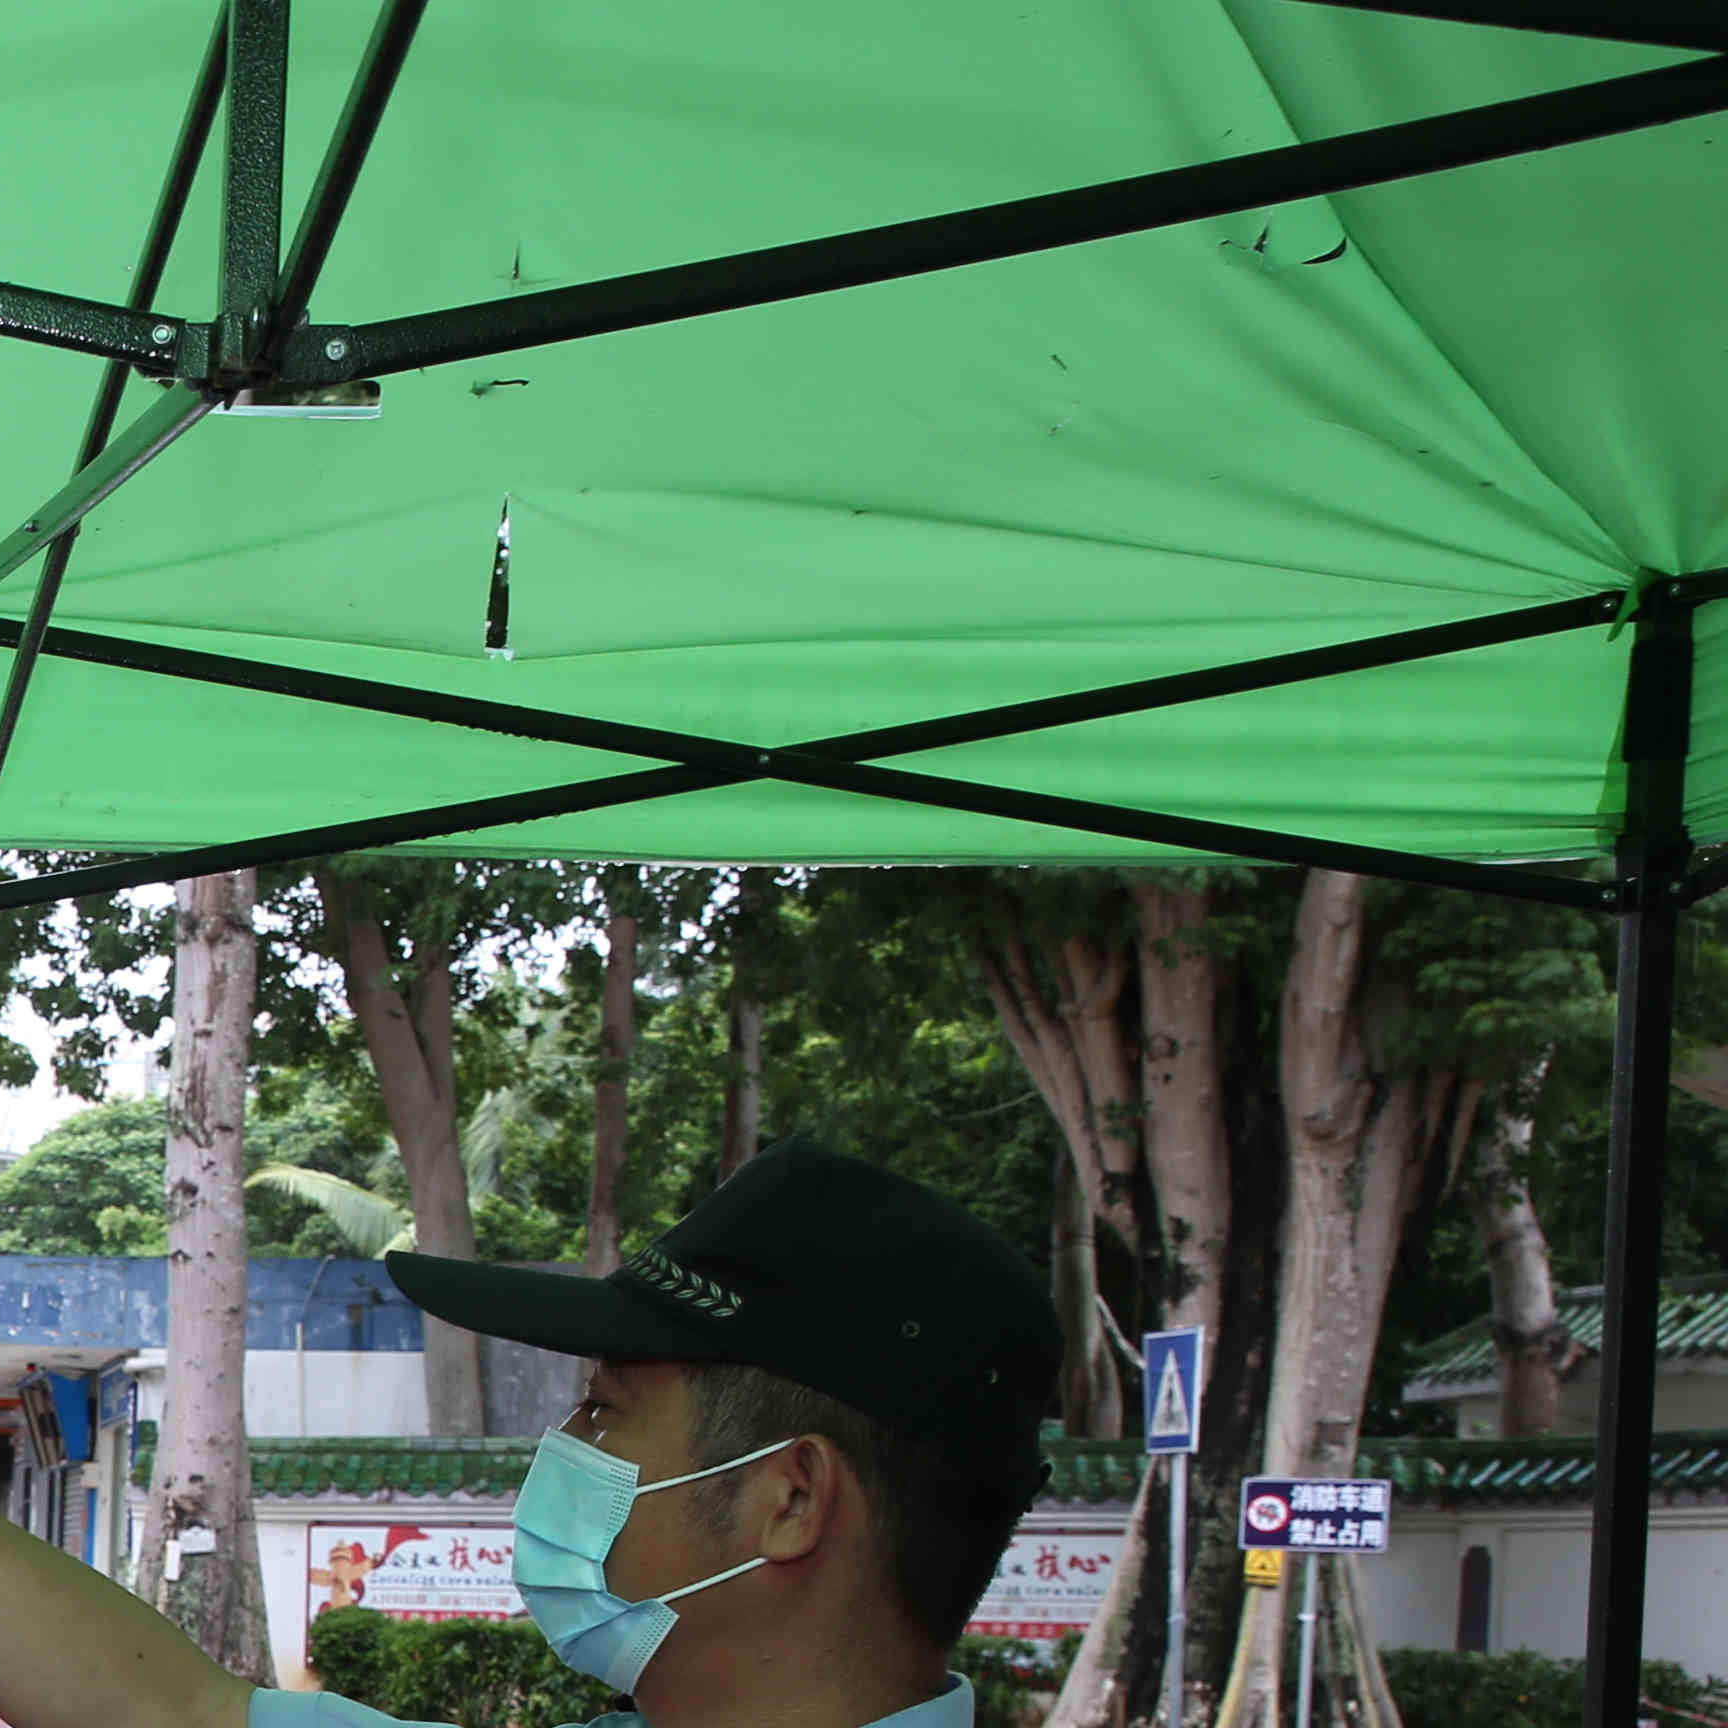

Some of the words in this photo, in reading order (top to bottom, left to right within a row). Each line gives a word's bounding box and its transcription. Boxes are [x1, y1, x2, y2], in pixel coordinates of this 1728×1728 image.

[1290, 1484, 1385, 1512] 消防车道
[1289, 1517, 1384, 1546] 禁止占用
